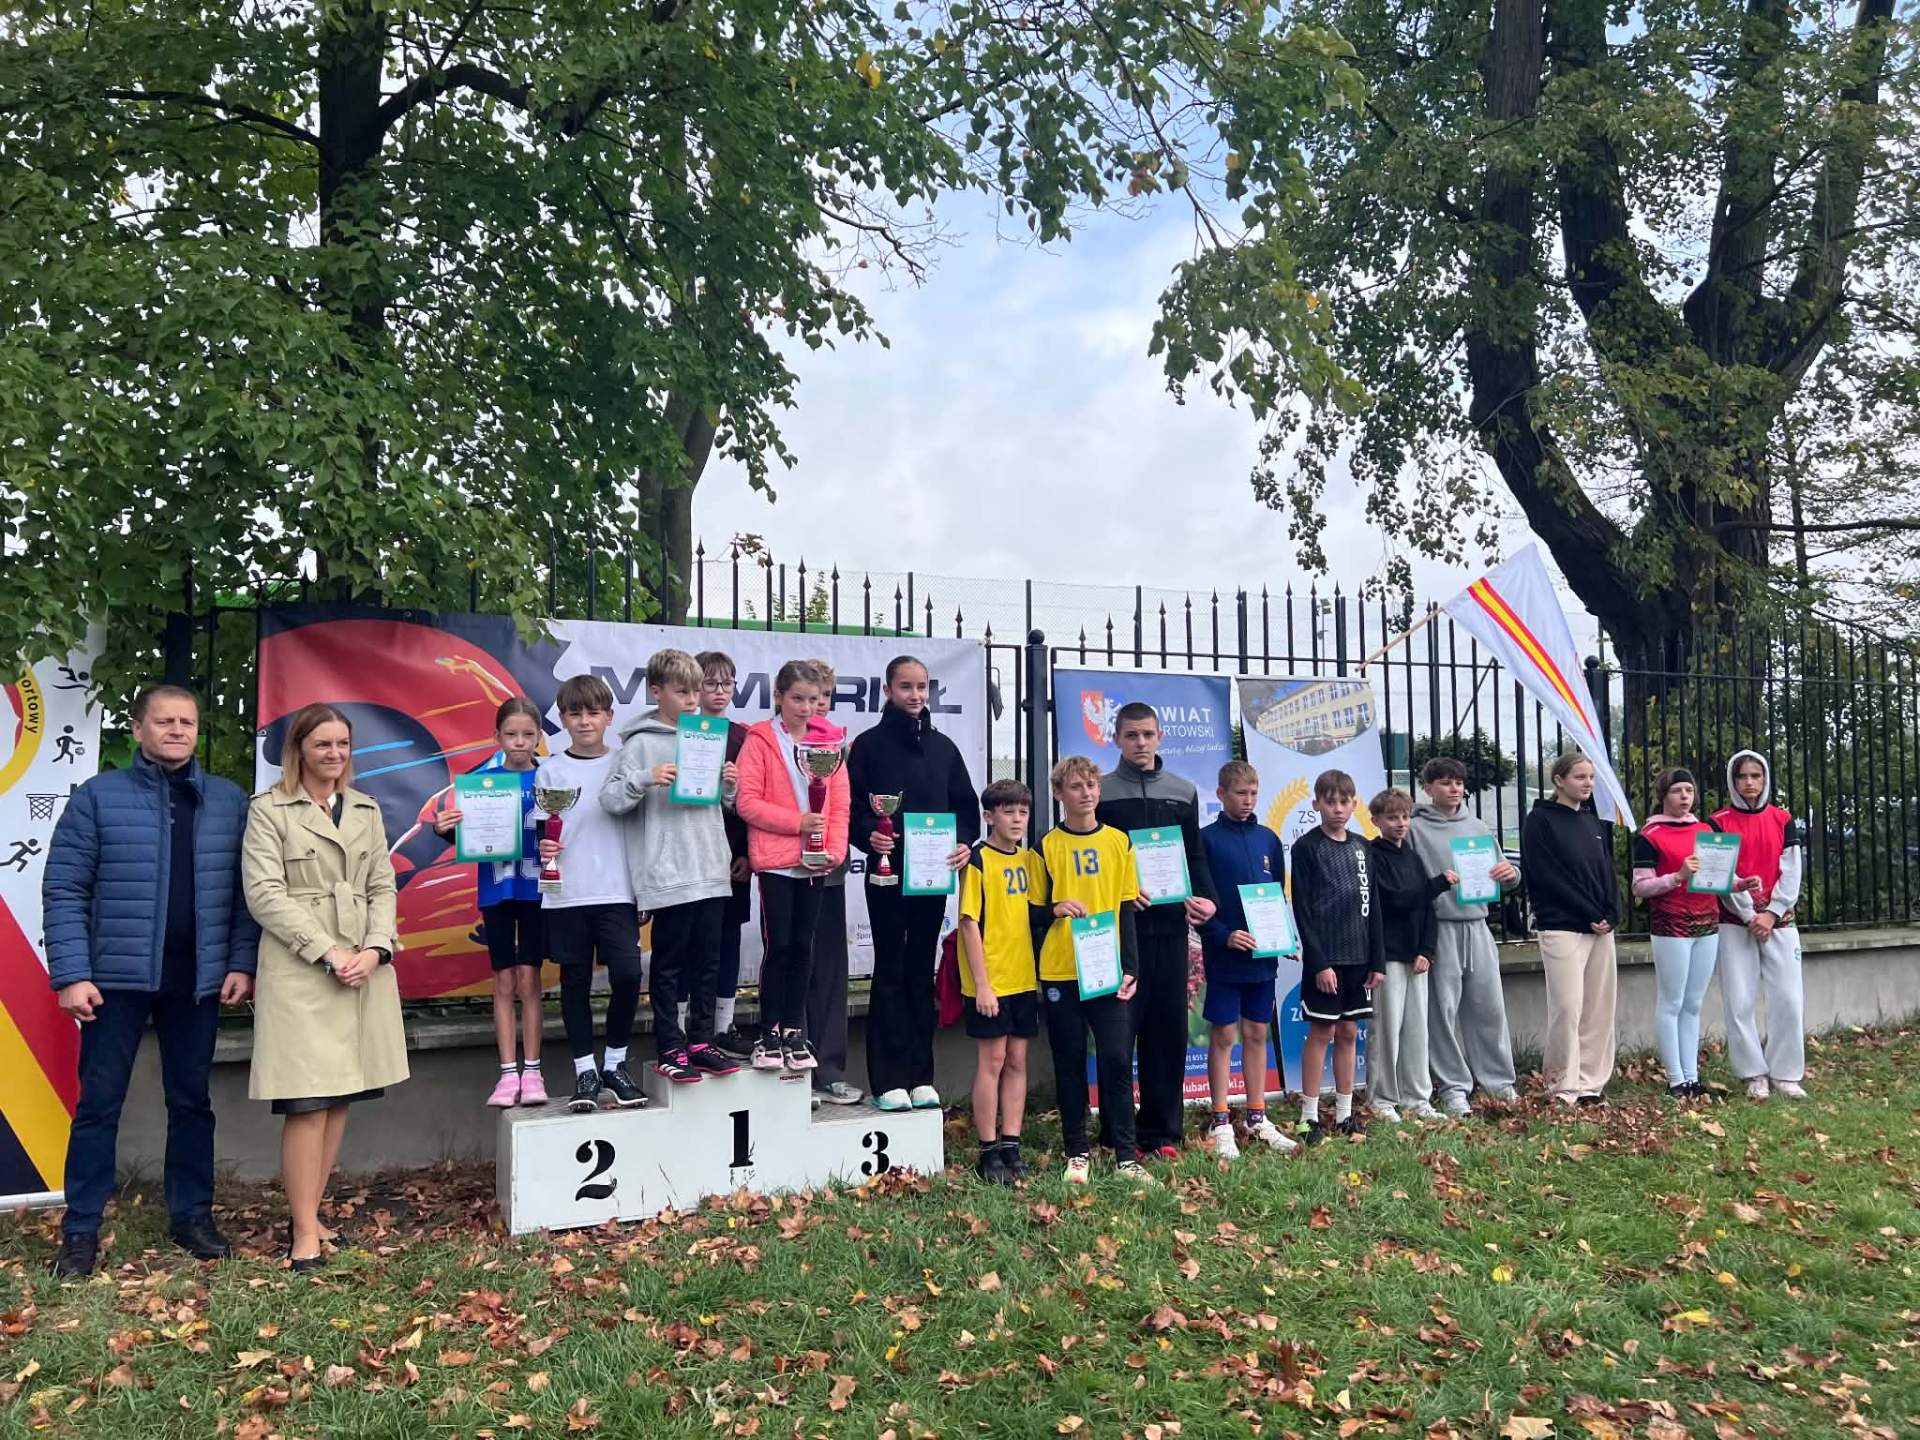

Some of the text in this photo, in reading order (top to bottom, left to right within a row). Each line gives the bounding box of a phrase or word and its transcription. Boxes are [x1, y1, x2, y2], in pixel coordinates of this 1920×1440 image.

[1297, 810, 1317, 824] ZS
[1004, 866, 1028, 896] 20
[1073, 848, 1099, 877] 13
[1356, 850, 1370, 917] adidas
[728, 1109, 755, 1168] 1
[861, 1131, 890, 1177] 3
[575, 1139, 618, 1201] 2
